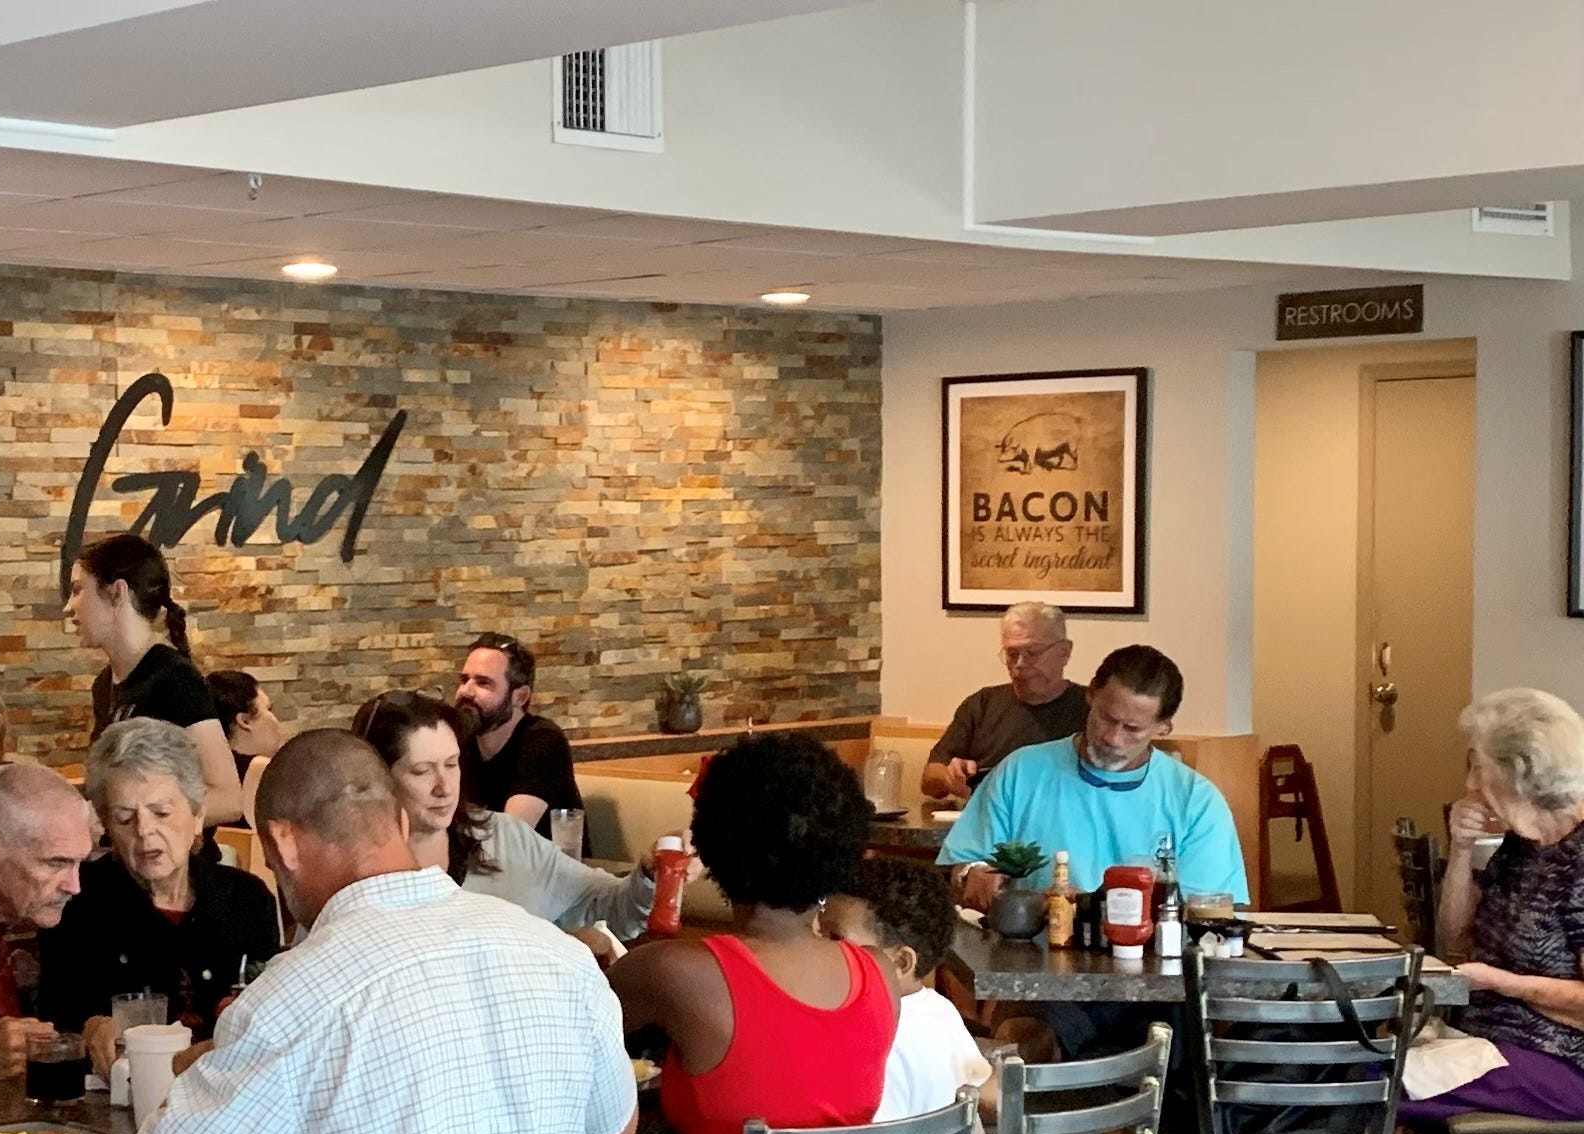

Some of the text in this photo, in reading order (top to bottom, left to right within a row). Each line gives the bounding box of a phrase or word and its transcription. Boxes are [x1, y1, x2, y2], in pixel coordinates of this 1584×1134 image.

[1284, 298, 1415, 326] RESTROOMS
[60, 371, 409, 603] Grind
[973, 490, 1109, 523] BACON
[971, 525, 1111, 543] IS ALWAYS THE
[970, 545, 1116, 580] secret ingredient
